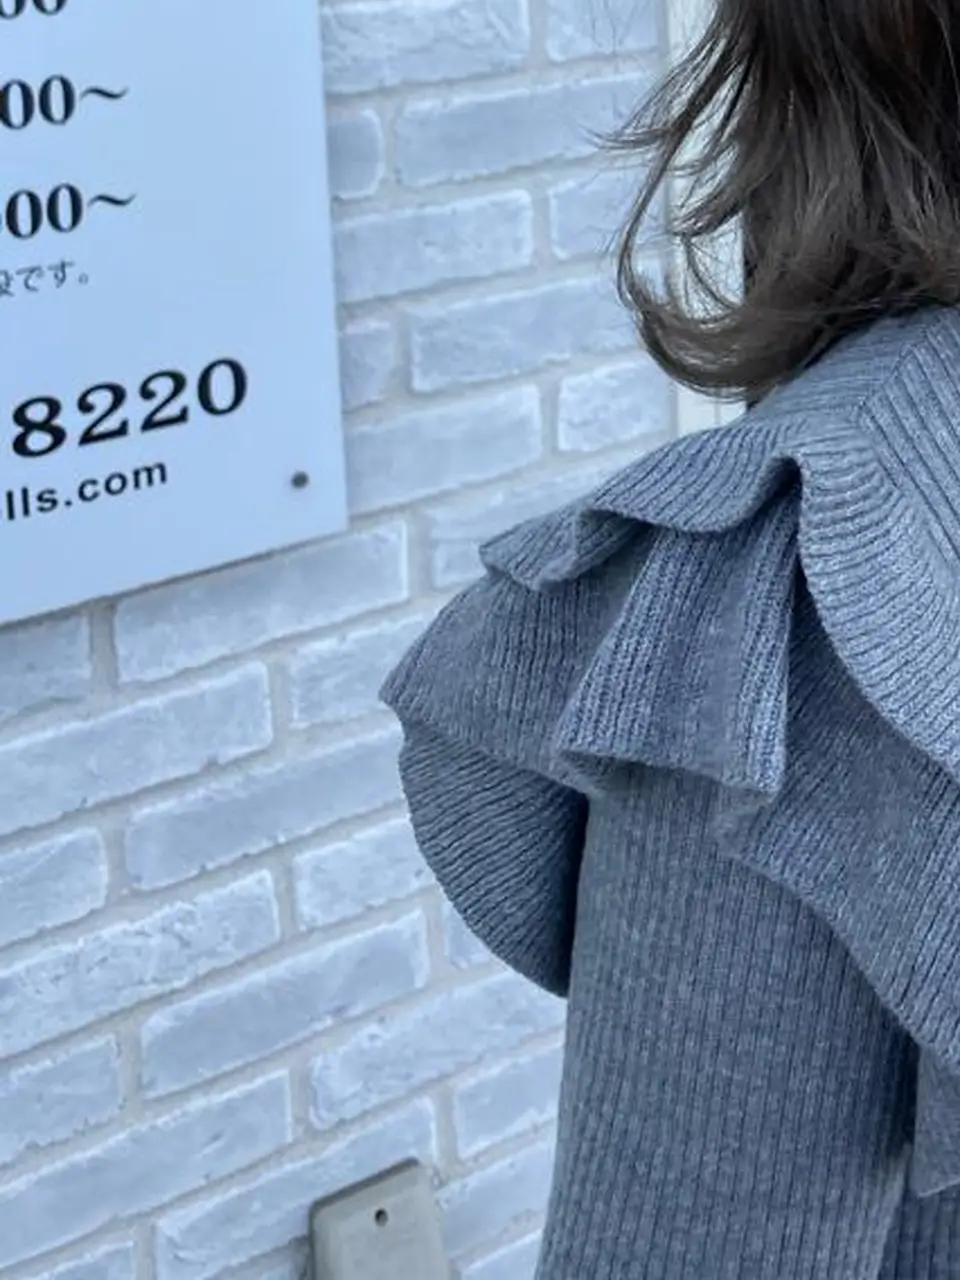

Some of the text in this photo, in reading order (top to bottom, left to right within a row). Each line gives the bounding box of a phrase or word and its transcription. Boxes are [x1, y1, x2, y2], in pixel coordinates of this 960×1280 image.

[0, 182, 137, 240] 00~
[11, 357, 248, 459] 8220
[0, 462, 168, 521] lls.com
